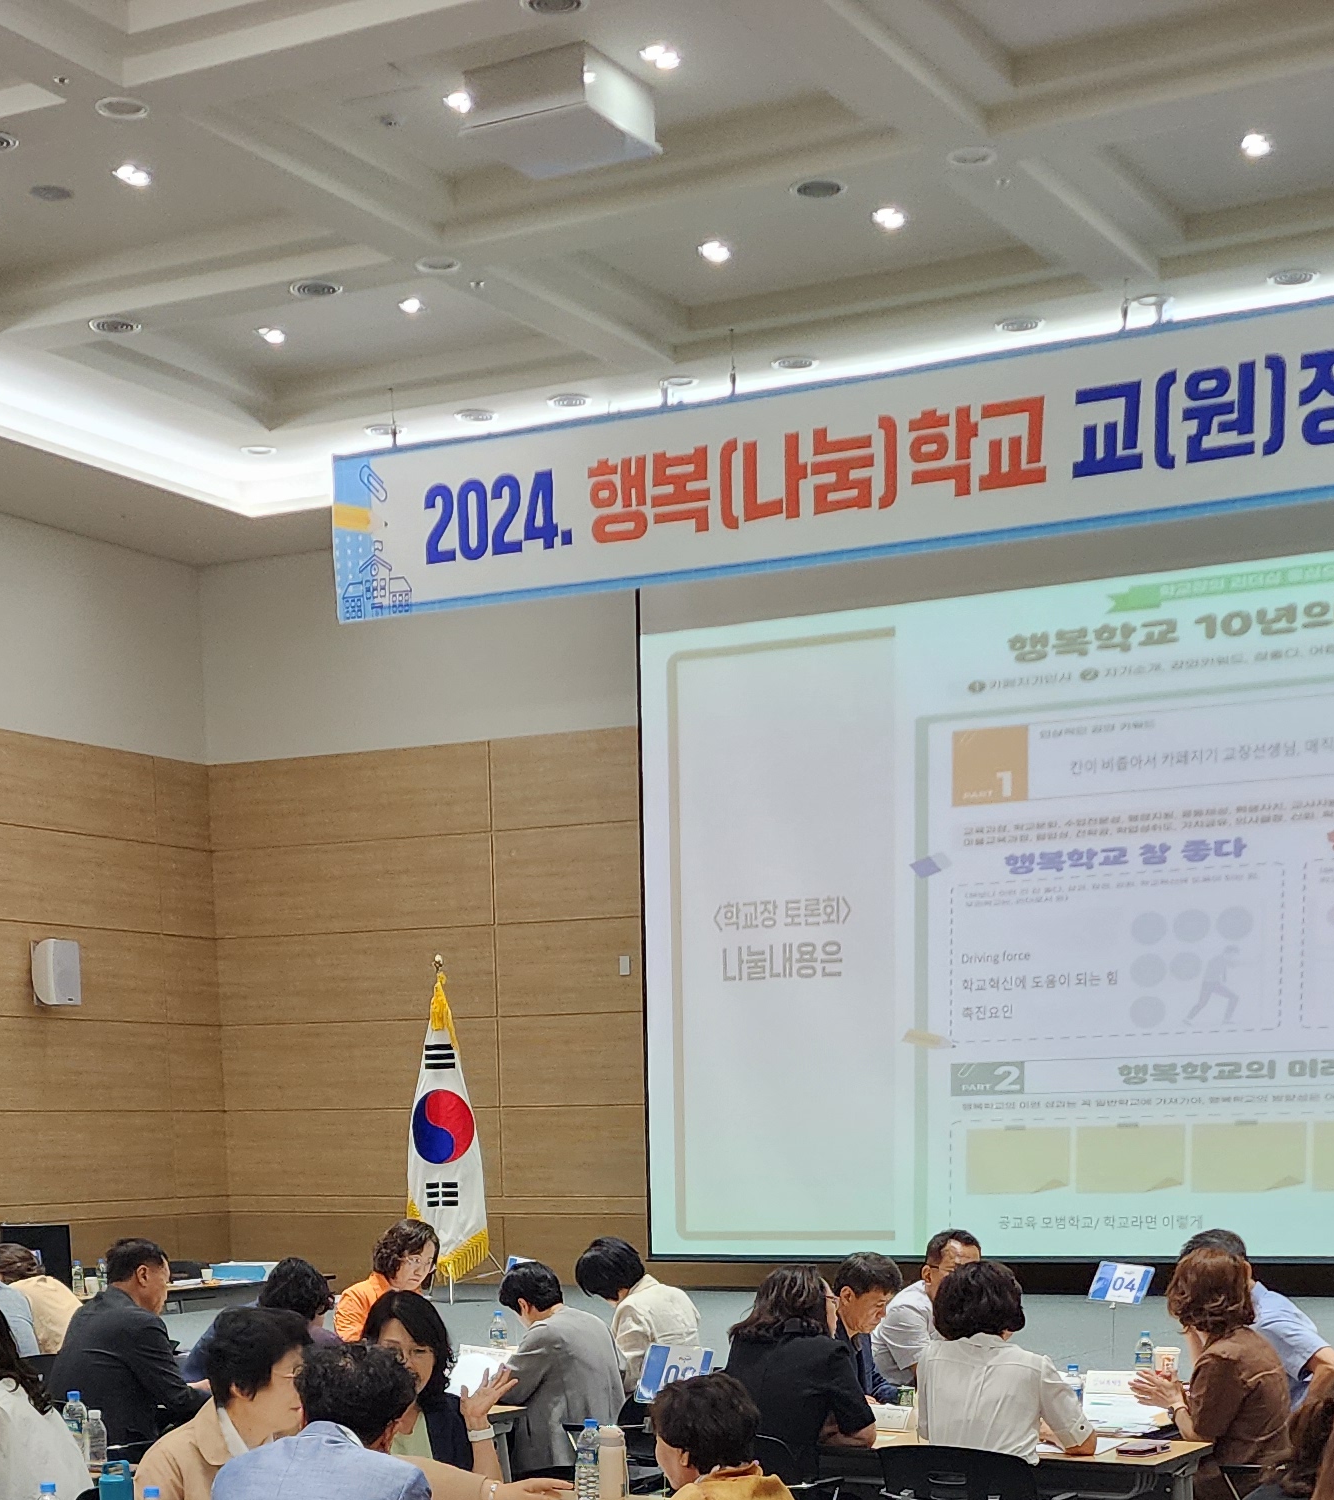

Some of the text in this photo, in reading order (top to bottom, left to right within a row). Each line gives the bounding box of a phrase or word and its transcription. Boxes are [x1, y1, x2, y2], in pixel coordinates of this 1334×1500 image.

[422, 469, 573, 566] 2024.
[586, 394, 1047, 546] 행복(나눔)학교
[1007, 618, 1180, 663] 행복학교
[1004, 836, 1248, 876] 행복학교 참 좋다
[960, 949, 1032, 966] Driving force
[961, 968, 1120, 993] 학교혁신에 도움이 되는 힘
[993, 1065, 1022, 1092] 2
[1117, 1058, 1277, 1086] 행복학교의
[998, 1215, 1039, 1231] 공교육
[1103, 1214, 1158, 1230] 학교라면
[1111, 1276, 1137, 1293] 04
